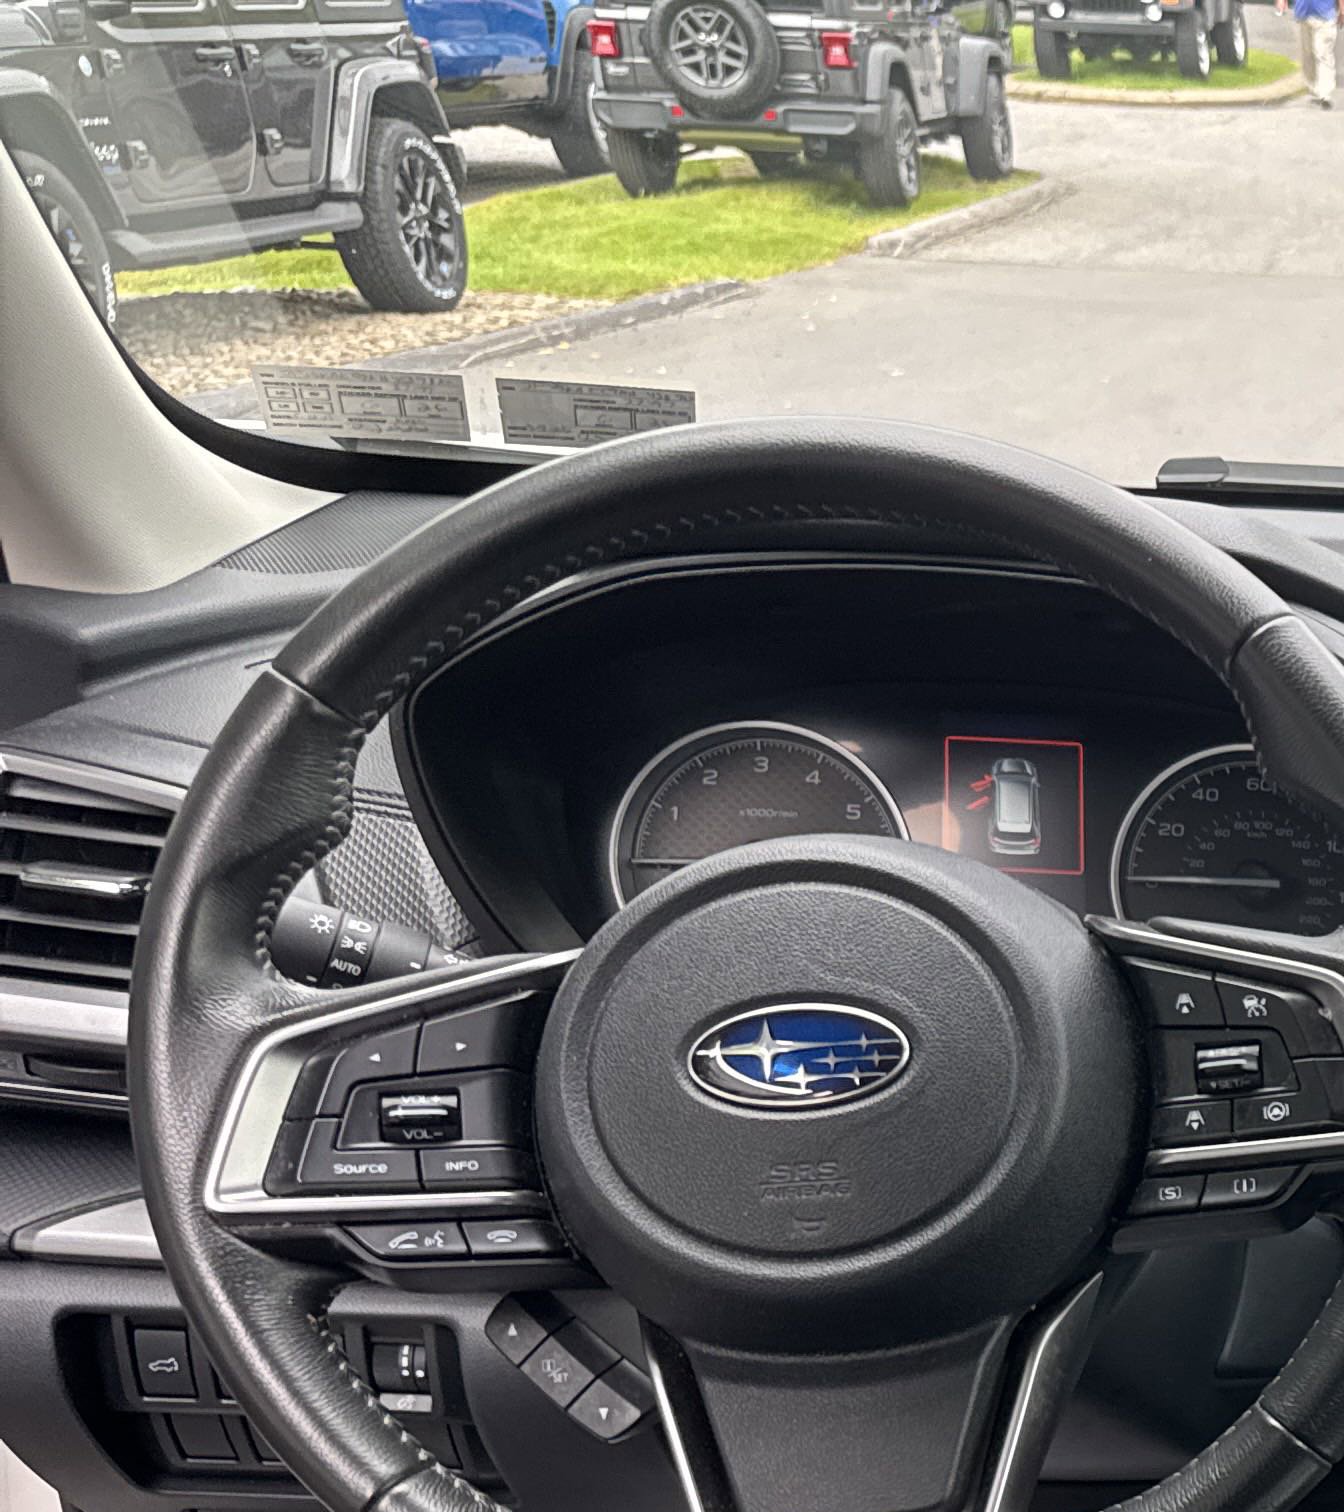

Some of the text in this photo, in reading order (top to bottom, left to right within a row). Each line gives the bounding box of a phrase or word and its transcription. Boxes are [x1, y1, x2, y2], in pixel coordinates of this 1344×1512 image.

[753, 756, 769, 772] 3
[702, 769, 718, 785] 2
[805, 770, 821, 784] 4
[1192, 788, 1219, 801] 40
[670, 806, 678, 821] 1
[845, 804, 861, 820] 5
[1158, 822, 1184, 837] 20
[330, 957, 362, 977] AUTO
[333, 1163, 388, 1175] Source
[445, 1160, 479, 1171] INFO
